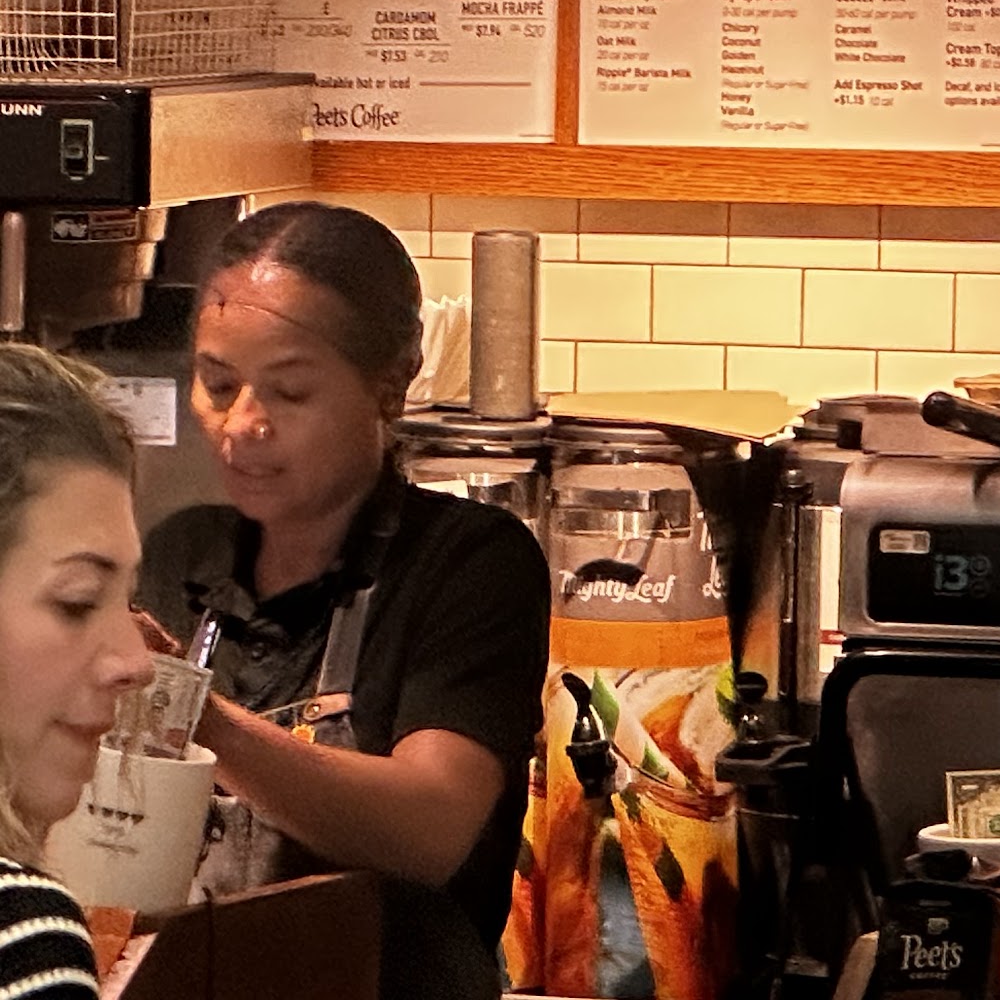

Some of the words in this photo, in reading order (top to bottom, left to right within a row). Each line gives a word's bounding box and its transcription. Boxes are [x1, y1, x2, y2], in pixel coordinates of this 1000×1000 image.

[461, 1, 500, 15] MOCHA
[502, 0, 544, 15] FRAPPÉ
[375, 11, 436, 24] CARDAMOM
[371, 27, 410, 41] CITRUS
[946, 42, 982, 55] Cream
[351, 103, 401, 130] Coffee
